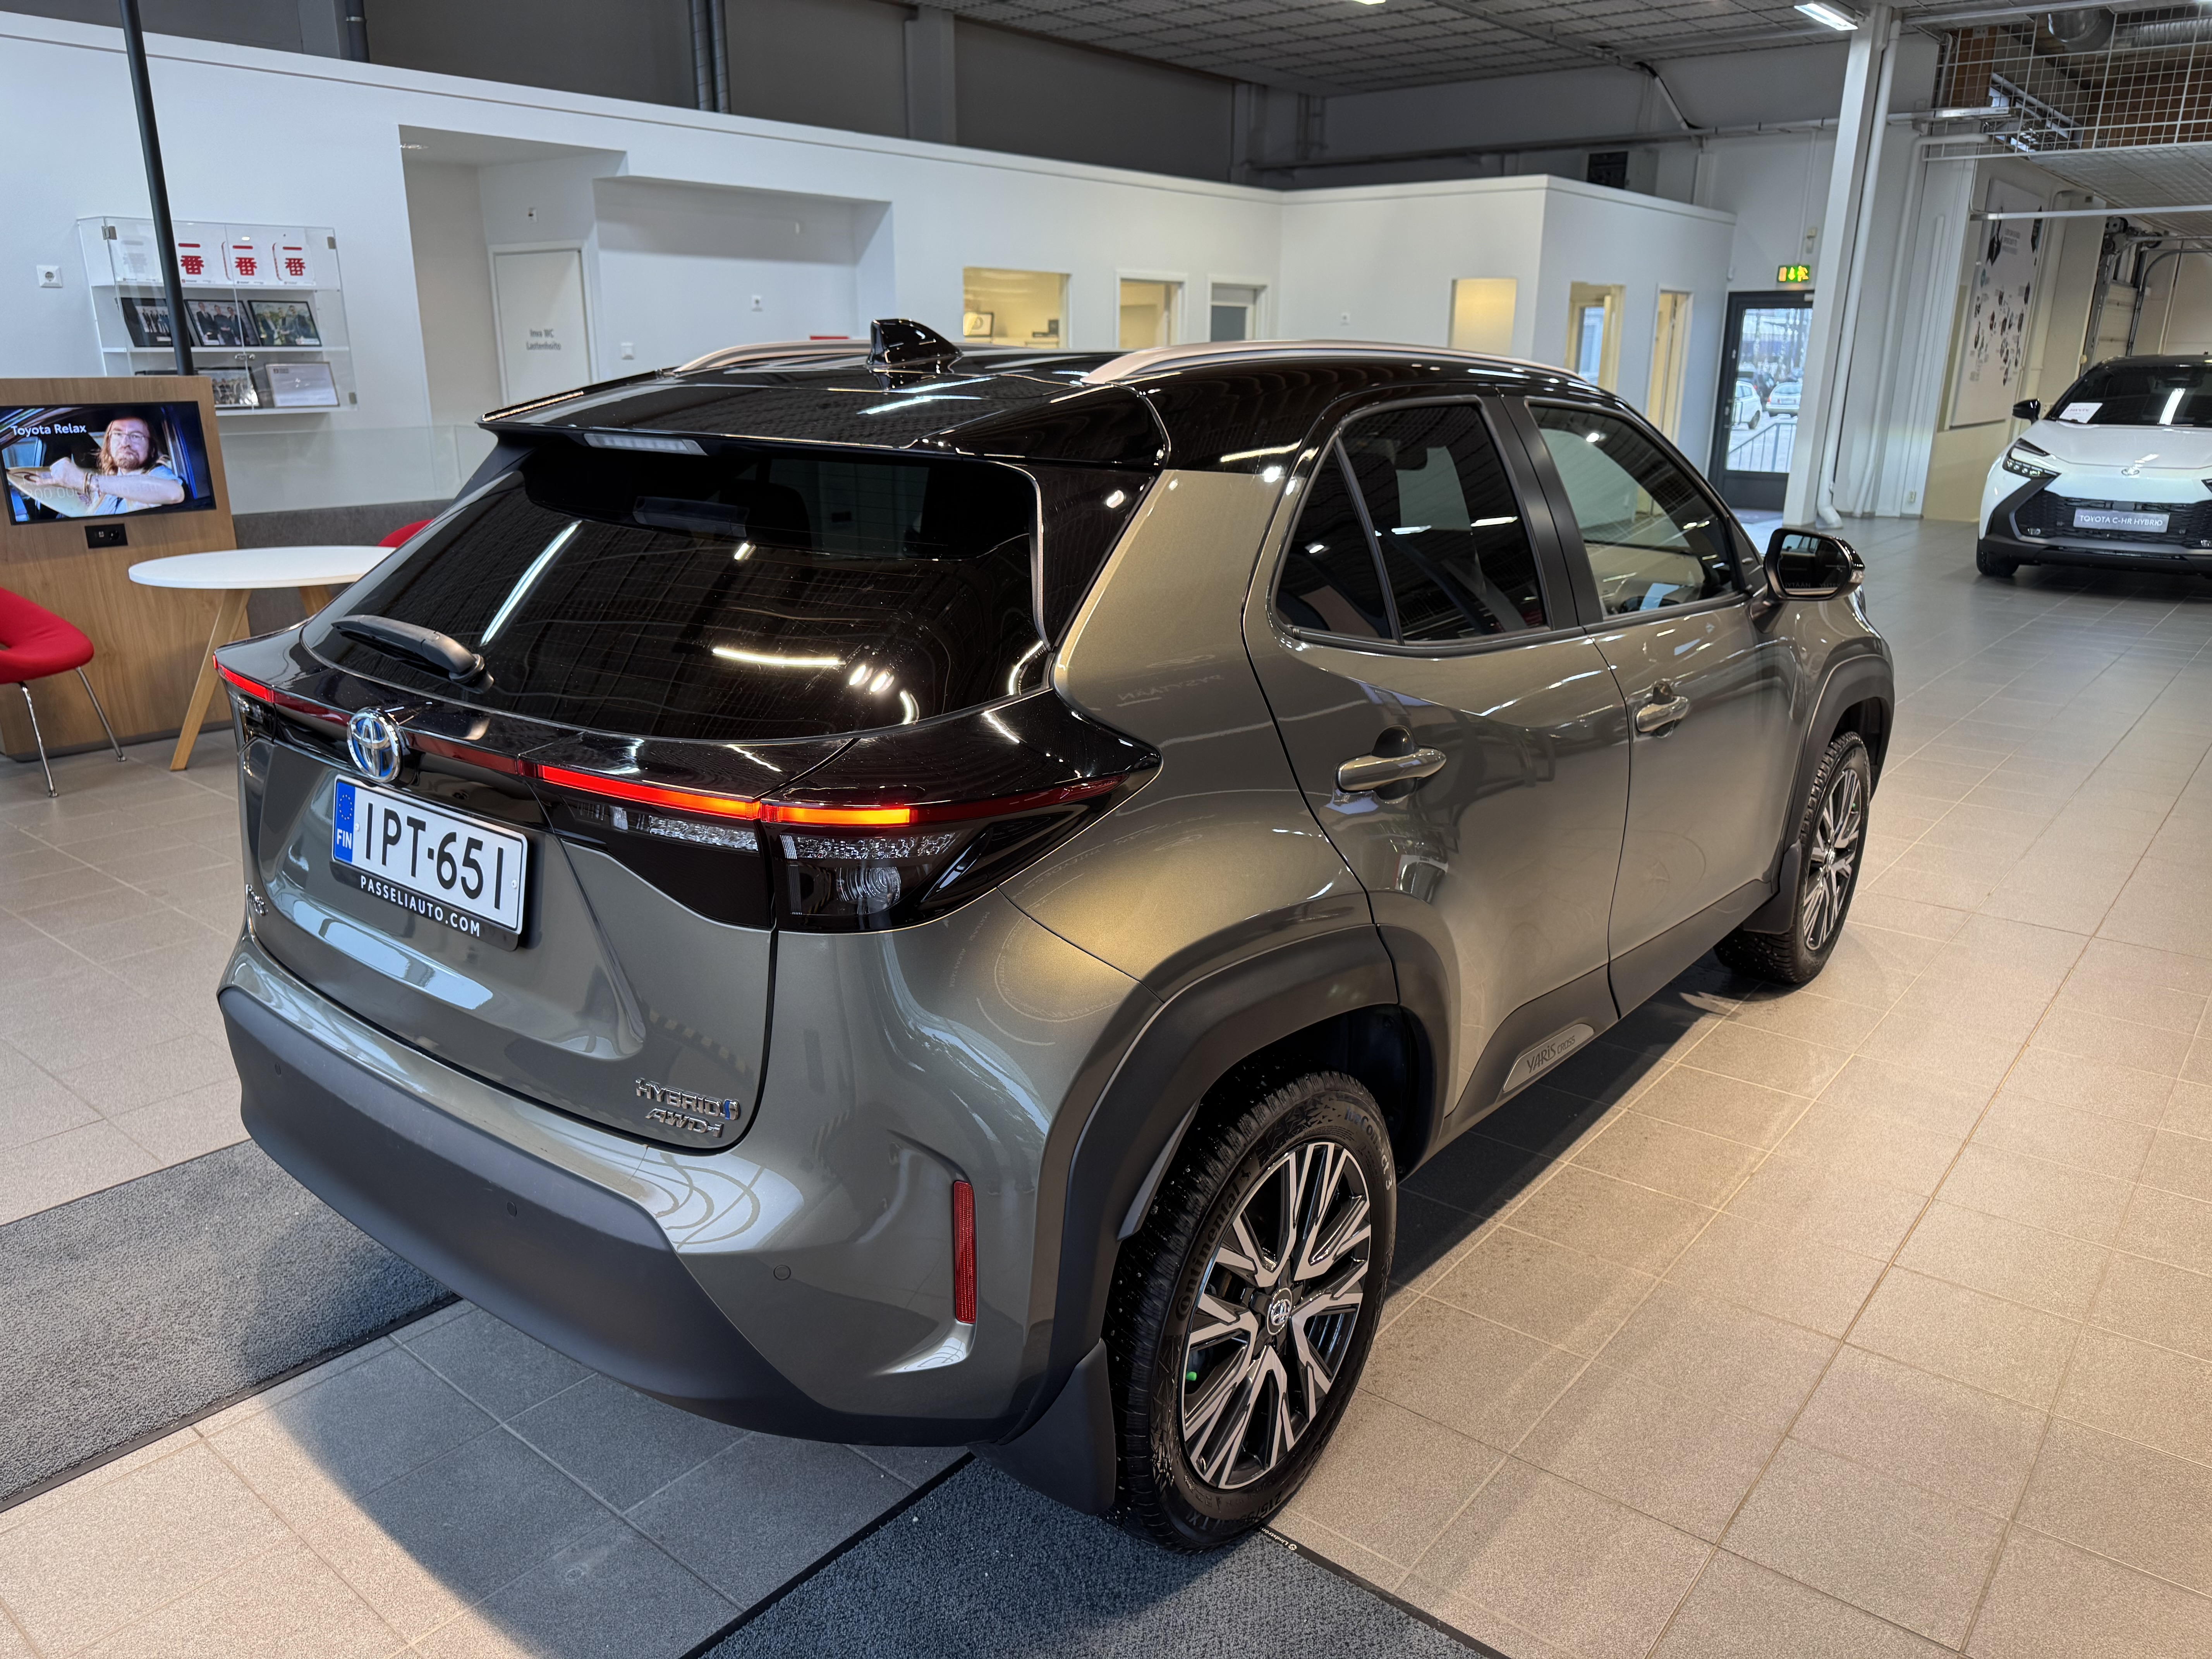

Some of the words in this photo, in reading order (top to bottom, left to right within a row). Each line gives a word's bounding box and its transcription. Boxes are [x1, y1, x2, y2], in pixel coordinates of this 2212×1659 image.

[11, 426, 51, 437] Toyota
[54, 423, 87, 434] Relax
[2080, 515, 2110, 523] TOYOTA
[2134, 518, 2163, 526] HYBRID
[337, 828, 352, 849] FIN
[366, 802, 503, 910] IPT-651
[361, 875, 480, 937] PASSELIAUTO.COM
[1557, 1035, 1575, 1054] CROSS
[635, 1078, 723, 1117] HYBRID
[1386, 1174, 1393, 1190] 3
[1175, 1182, 1241, 1321] Continental
